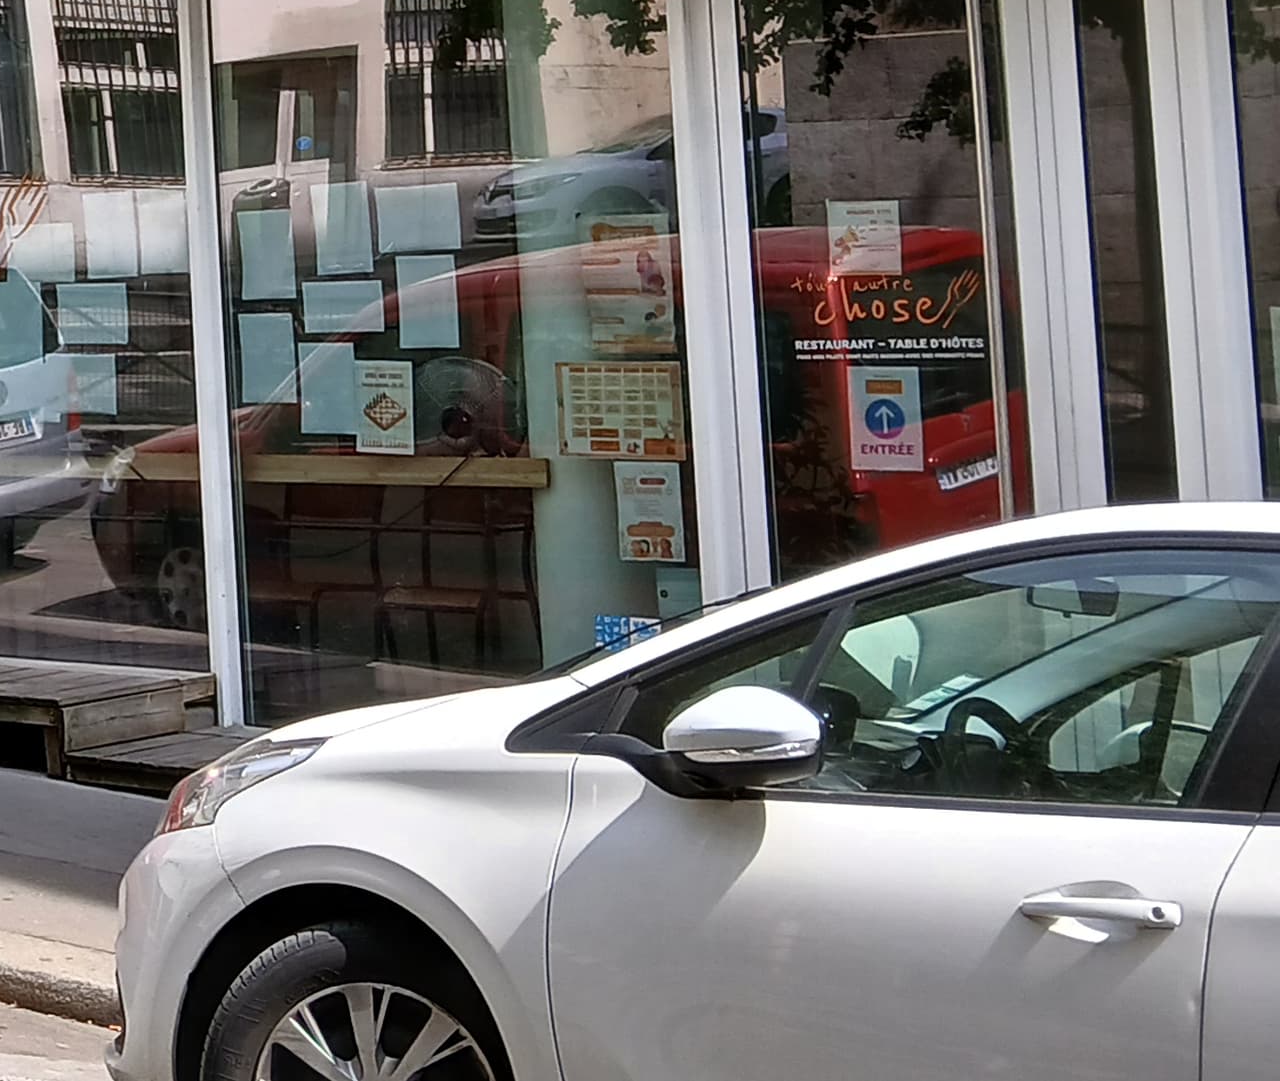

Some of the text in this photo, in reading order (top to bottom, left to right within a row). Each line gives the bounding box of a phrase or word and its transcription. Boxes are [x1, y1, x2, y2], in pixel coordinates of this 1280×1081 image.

[791, 272, 913, 293] tou autre
[814, 278, 948, 325] chose
[794, 339, 875, 351] RESTAURANT
[888, 338, 928, 350] TABLE
[930, 336, 985, 349] D'HÔTES
[860, 441, 915, 456] ENTRÉE
